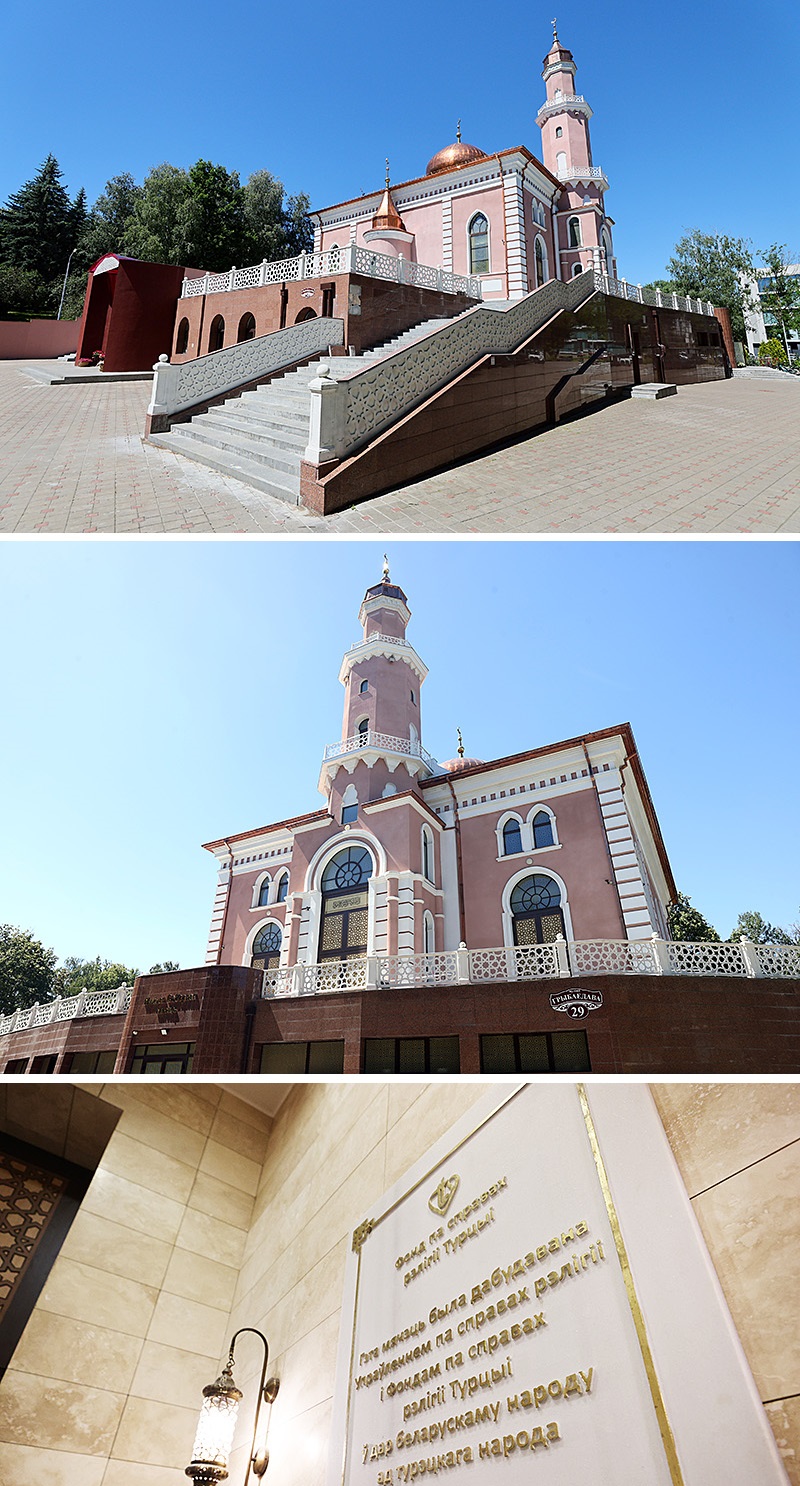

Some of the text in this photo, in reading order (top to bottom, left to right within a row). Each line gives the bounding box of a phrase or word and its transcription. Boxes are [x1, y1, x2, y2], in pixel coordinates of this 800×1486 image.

[571, 1006, 584, 1017] 29
[394, 1176, 508, 1270] Фонд па справах
[403, 1206, 495, 1287] рэлігіі Турцыі
[354, 1239, 606, 1390] Упраўленнем па справах рэлігіі
[359, 1219, 590, 1366] Гэта мячэць была дабудавана
[380, 1311, 548, 1402] і Фондам па справах
[403, 1356, 513, 1422] рэлігіі Турцыі
[361, 1367, 595, 1465] ў дар беларускаму народу
[377, 1421, 562, 1486] ад турэцкага народа
